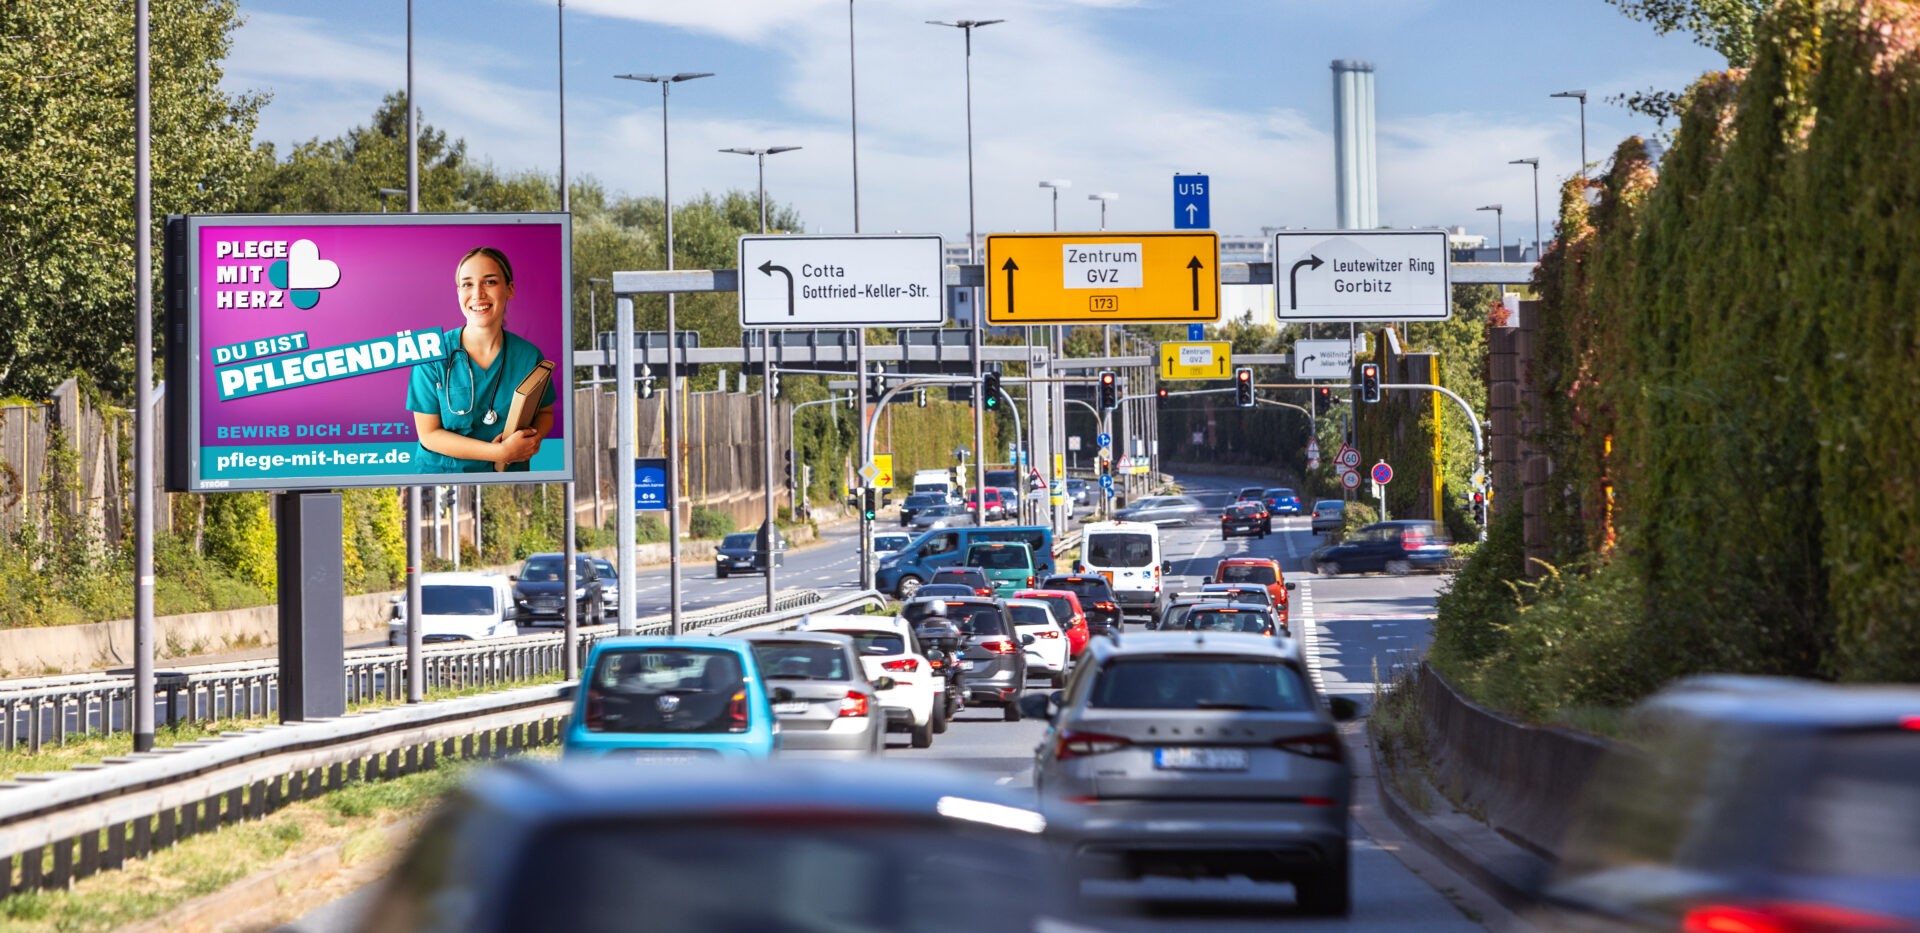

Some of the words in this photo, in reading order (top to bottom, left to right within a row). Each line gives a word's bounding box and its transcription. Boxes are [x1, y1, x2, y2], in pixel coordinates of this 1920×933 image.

[217, 241, 288, 259] PLEGE
[1068, 249, 1137, 263] Zentrum
[217, 266, 263, 283] MIT
[802, 263, 844, 278] Cotta
[1333, 258, 1403, 273] Leutewitzer
[1409, 258, 1435, 275] Ring
[1087, 269, 1119, 283] GVZ
[802, 283, 930, 299] Gottfried-Keller-Str.
[1334, 279, 1392, 293] Gorbitz
[217, 291, 283, 308] HERZ
[1094, 298, 1113, 309] 173
[216, 344, 247, 363] DU
[254, 333, 305, 356] BIST
[220, 329, 442, 396] PFLEGENDÄR
[217, 425, 290, 439] BEWIRB
[296, 423, 341, 437] DICH
[347, 422, 410, 436] JETZT:
[217, 449, 411, 471] pflege-mit-herz.de
[1345, 453, 1357, 463] 60
